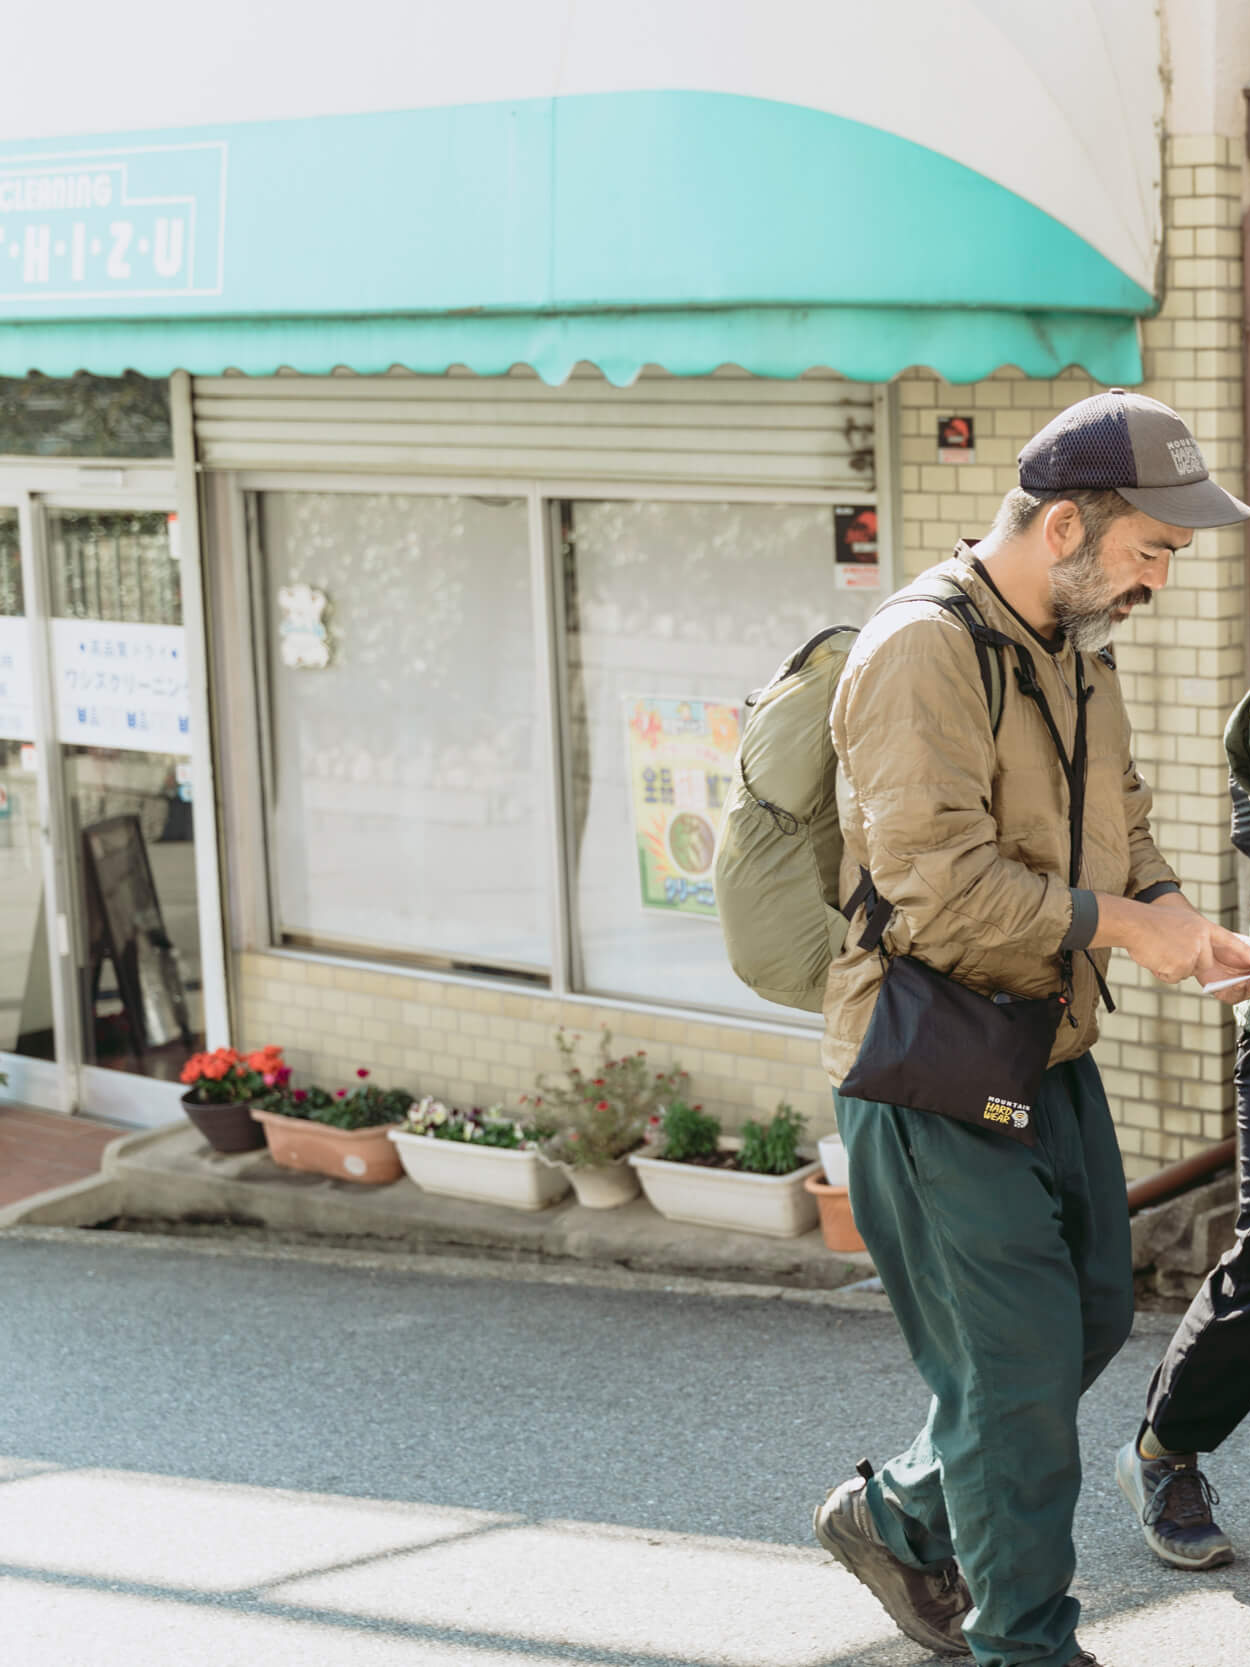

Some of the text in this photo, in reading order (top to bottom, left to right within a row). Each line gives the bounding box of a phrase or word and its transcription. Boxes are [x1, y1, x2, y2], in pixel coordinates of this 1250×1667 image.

[985, 1102, 1012, 1116] HARD
[988, 1096, 1030, 1110] MOUNTAIN
[983, 1111, 1010, 1124] WEAR
